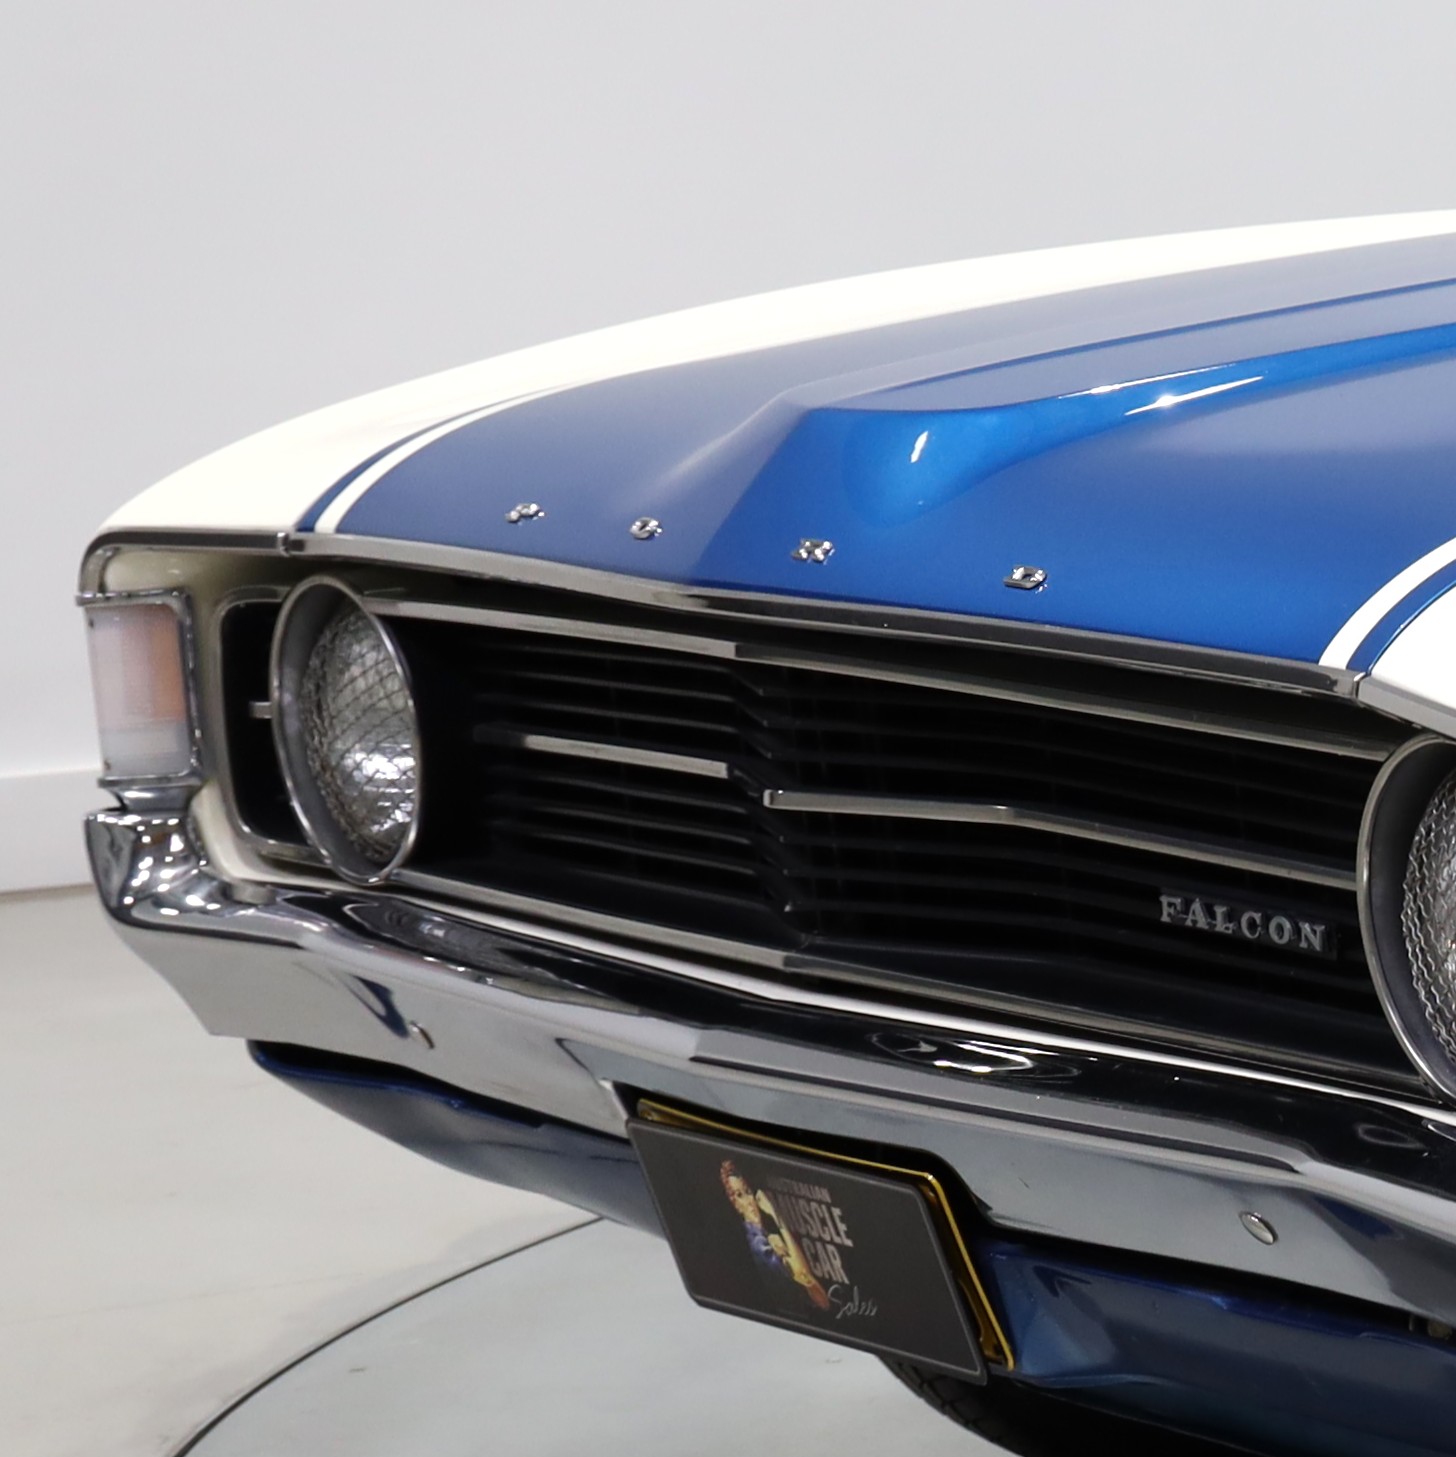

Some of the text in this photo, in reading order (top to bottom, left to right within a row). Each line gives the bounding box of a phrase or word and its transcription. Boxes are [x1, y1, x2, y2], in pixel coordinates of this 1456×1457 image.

[1159, 895, 1326, 951] FALCON
[767, 1178, 831, 1203] TRALIAN
[802, 1237, 850, 1284] CAR
